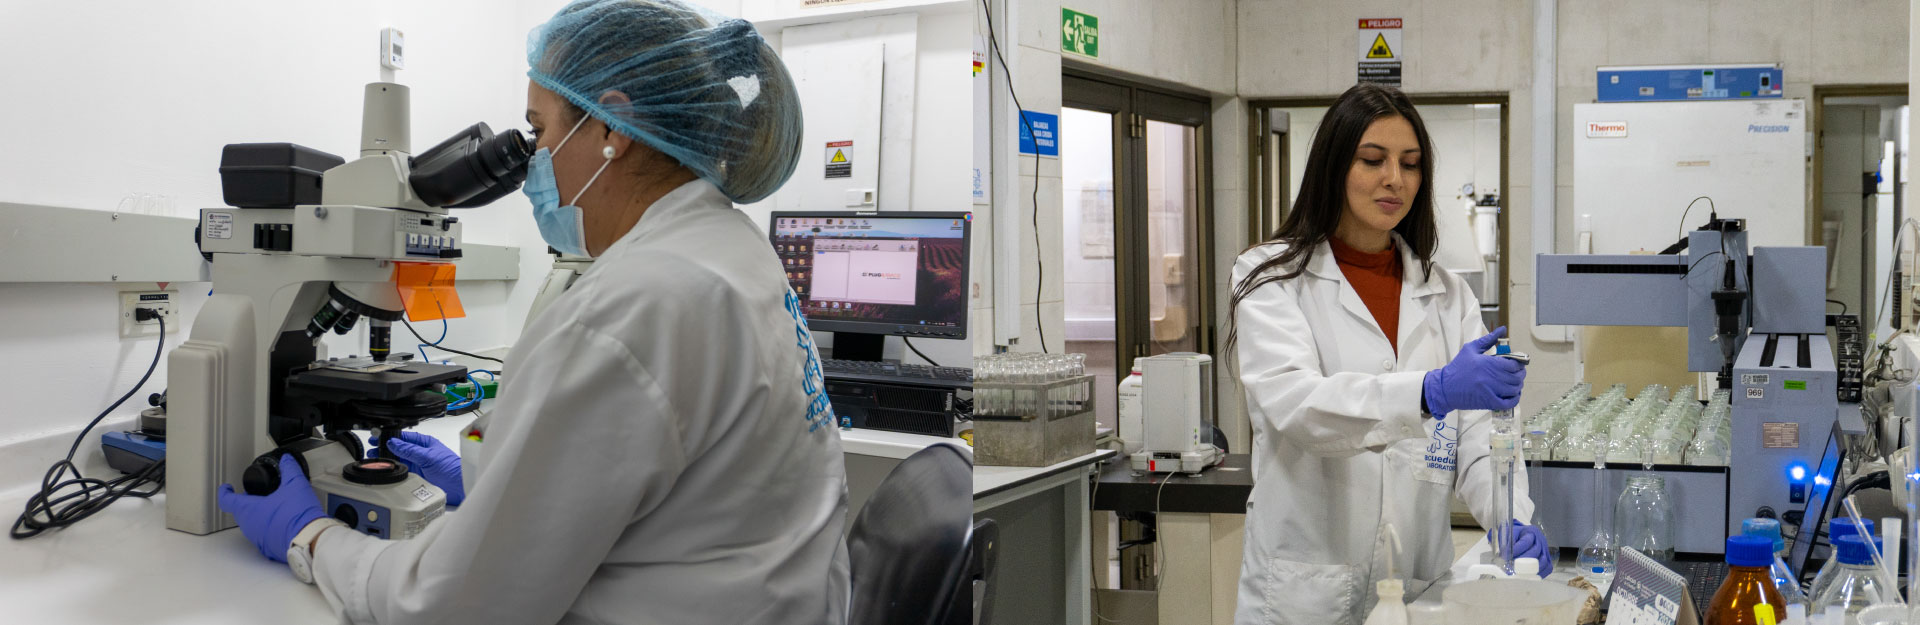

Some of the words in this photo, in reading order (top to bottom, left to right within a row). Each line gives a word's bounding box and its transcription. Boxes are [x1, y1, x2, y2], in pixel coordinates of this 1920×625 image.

[1368, 19, 1401, 28] PELIGRO
[1084, 25, 1098, 37] SALIDA
[1589, 123, 1625, 132] Thermo
[1748, 124, 1790, 133] PRECISION
